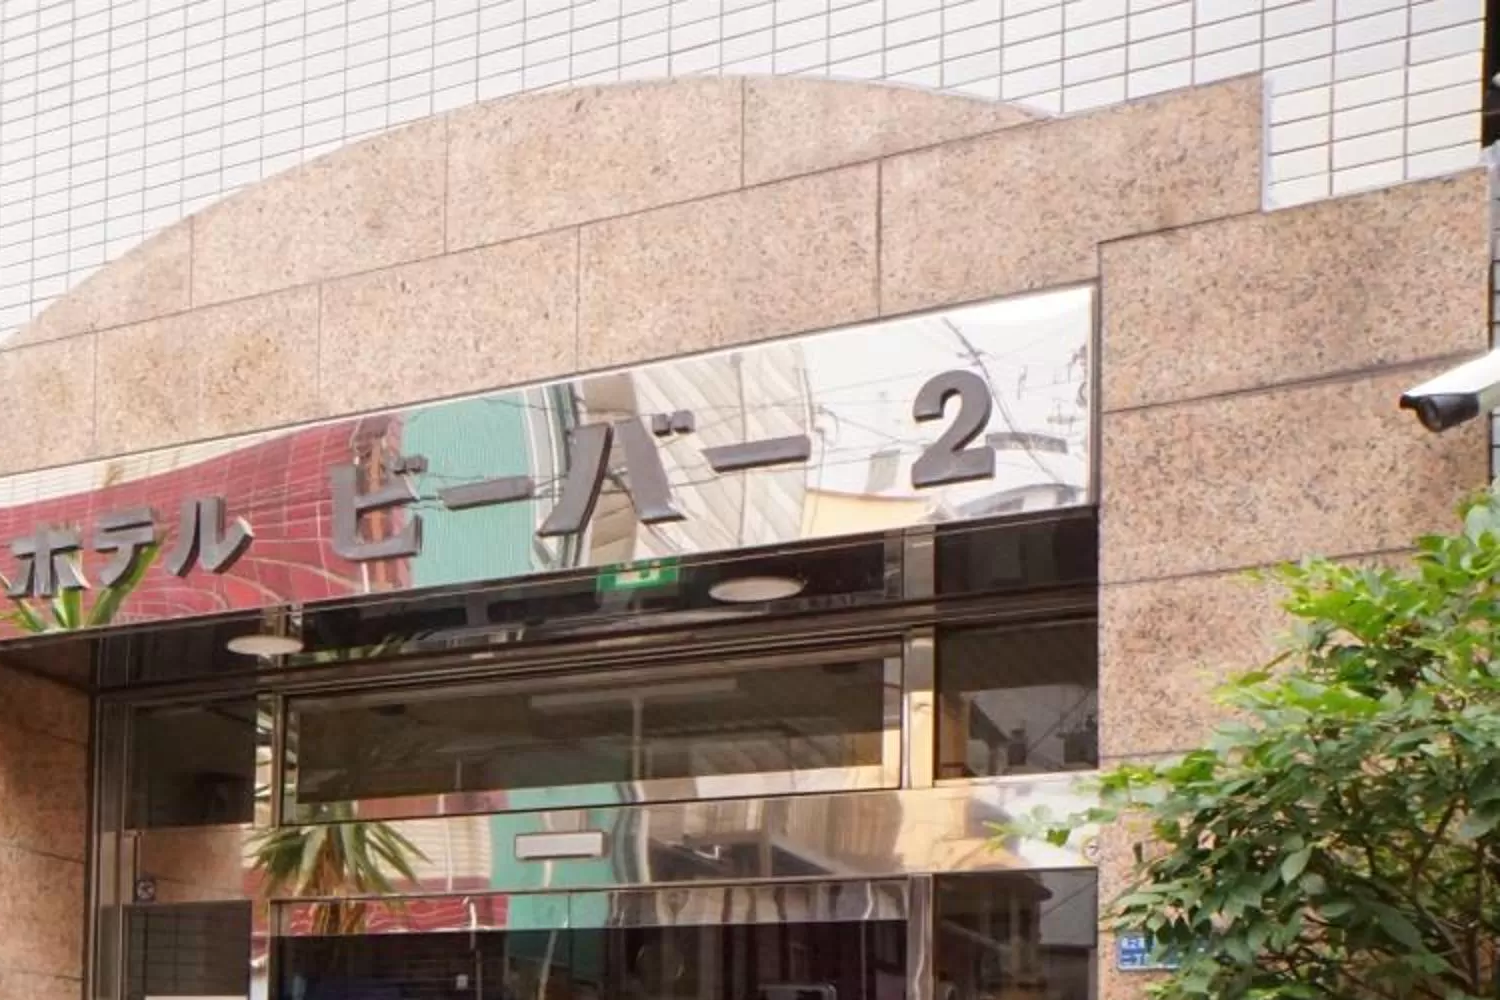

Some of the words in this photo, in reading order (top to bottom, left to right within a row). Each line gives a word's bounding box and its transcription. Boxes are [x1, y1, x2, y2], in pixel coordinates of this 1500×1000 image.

[9, 497, 253, 600] ホテル
[329, 409, 813, 564] ビーバー
[911, 368, 996, 489] 2
